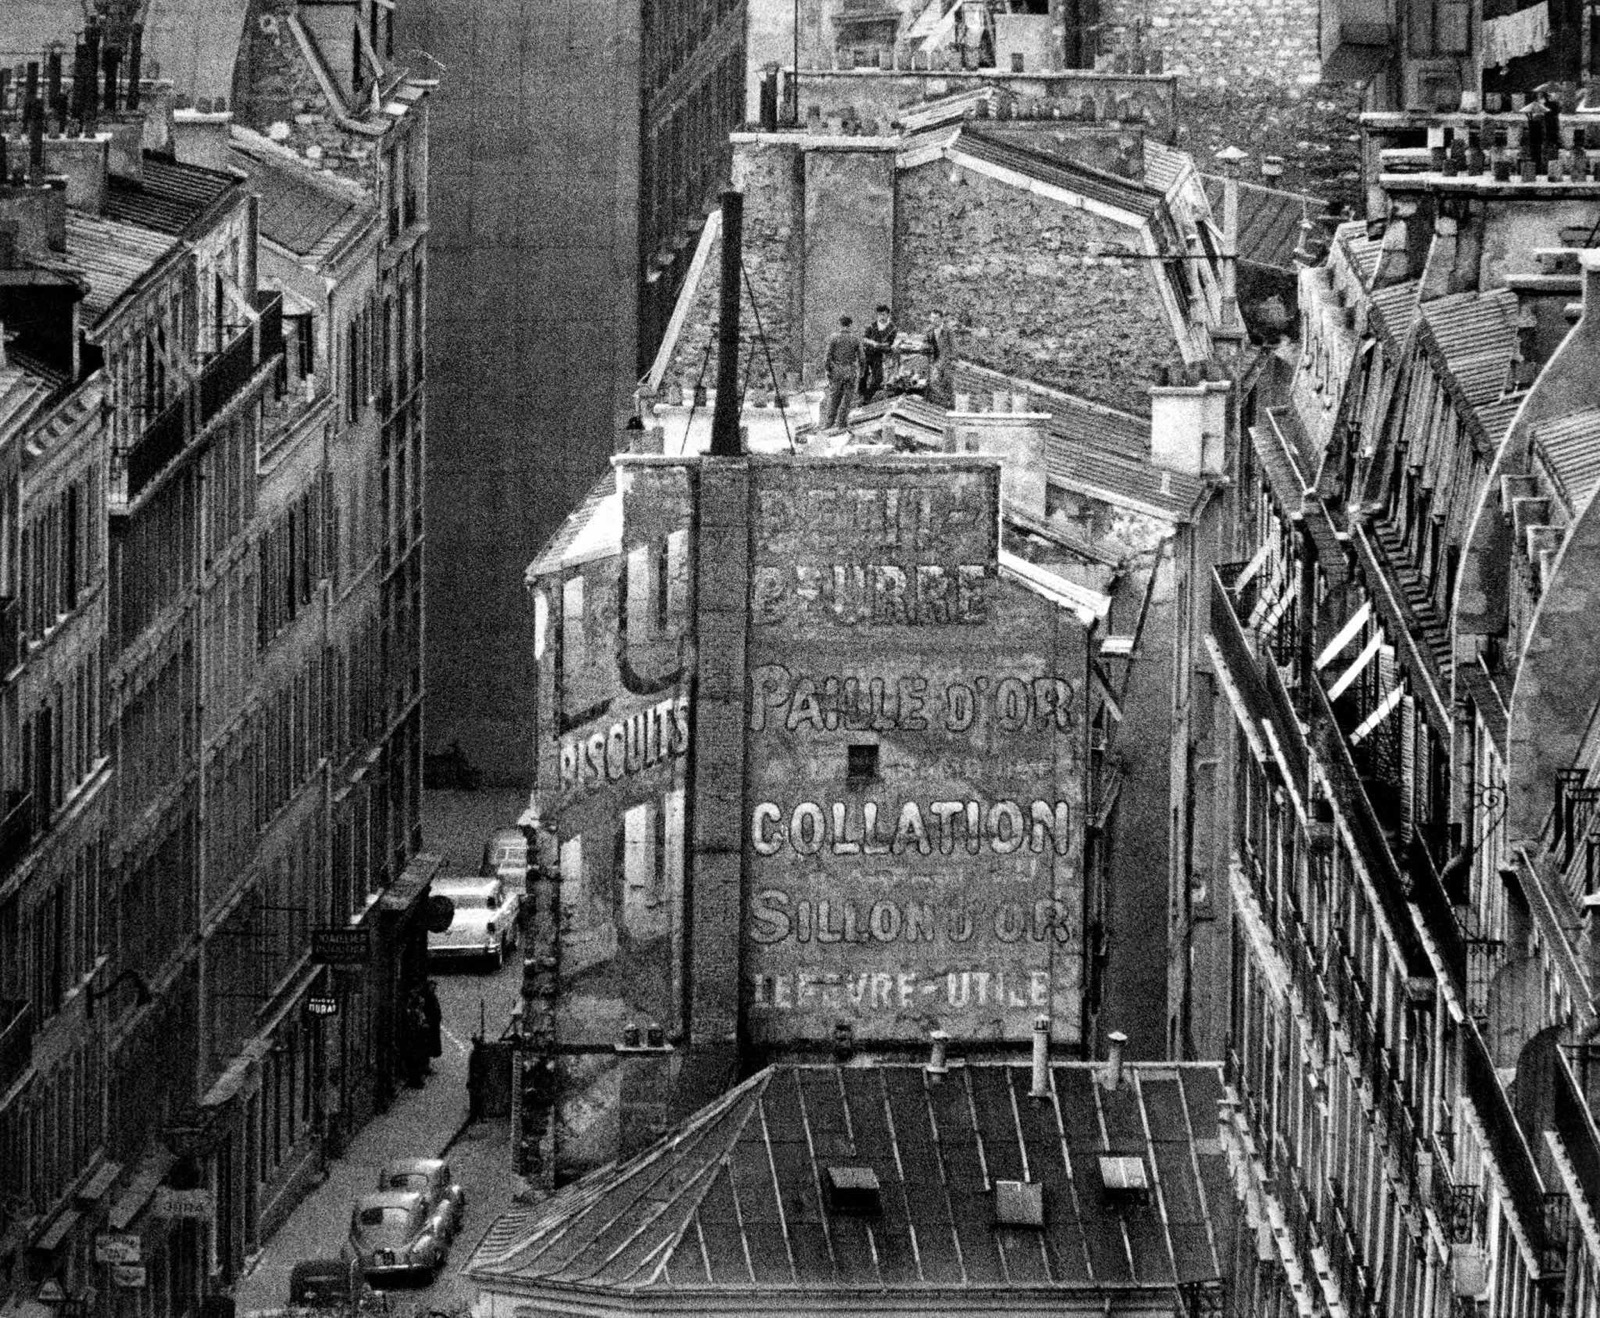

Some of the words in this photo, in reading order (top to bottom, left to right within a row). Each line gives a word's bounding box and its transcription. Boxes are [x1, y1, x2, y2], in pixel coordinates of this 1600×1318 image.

[750, 663, 929, 732] PAILLE
[559, 697, 689, 788] BISCUITS
[750, 800, 1070, 856] COLLATION
[750, 889, 936, 944] SILLON
